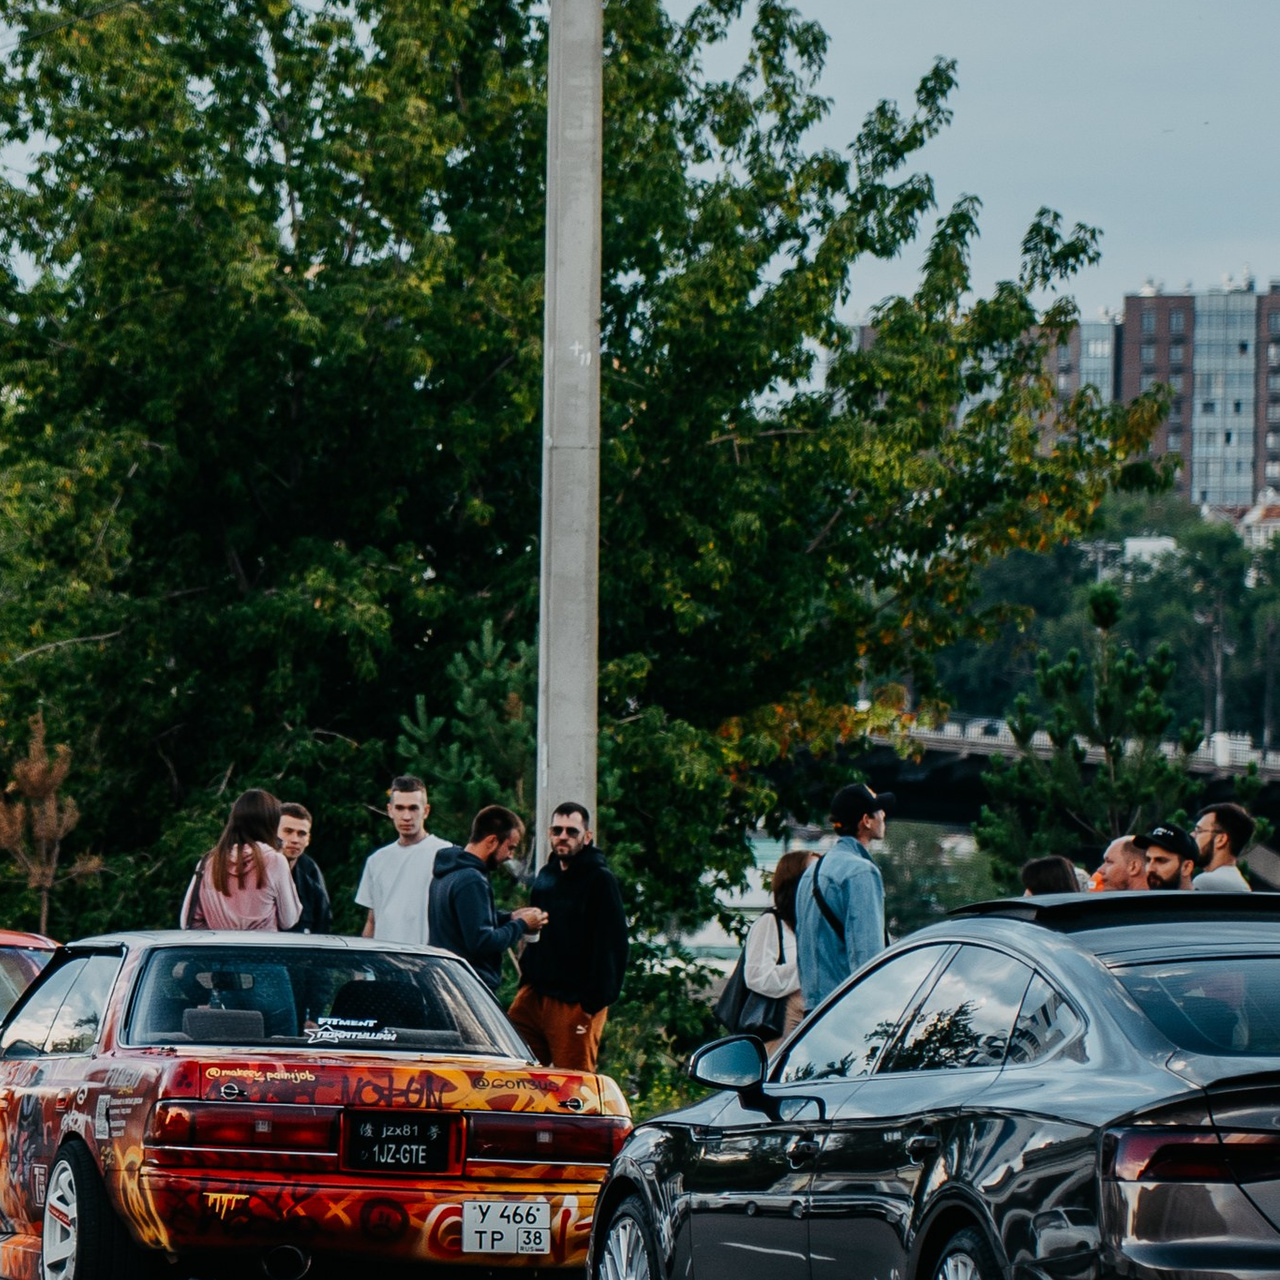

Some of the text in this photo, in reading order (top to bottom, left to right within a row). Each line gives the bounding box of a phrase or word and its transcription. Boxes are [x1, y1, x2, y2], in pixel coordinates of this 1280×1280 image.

[373, 1144, 427, 1164] 1JZ-GTE
[499, 1205, 537, 1224] 466
[523, 1230, 543, 1245] 38
